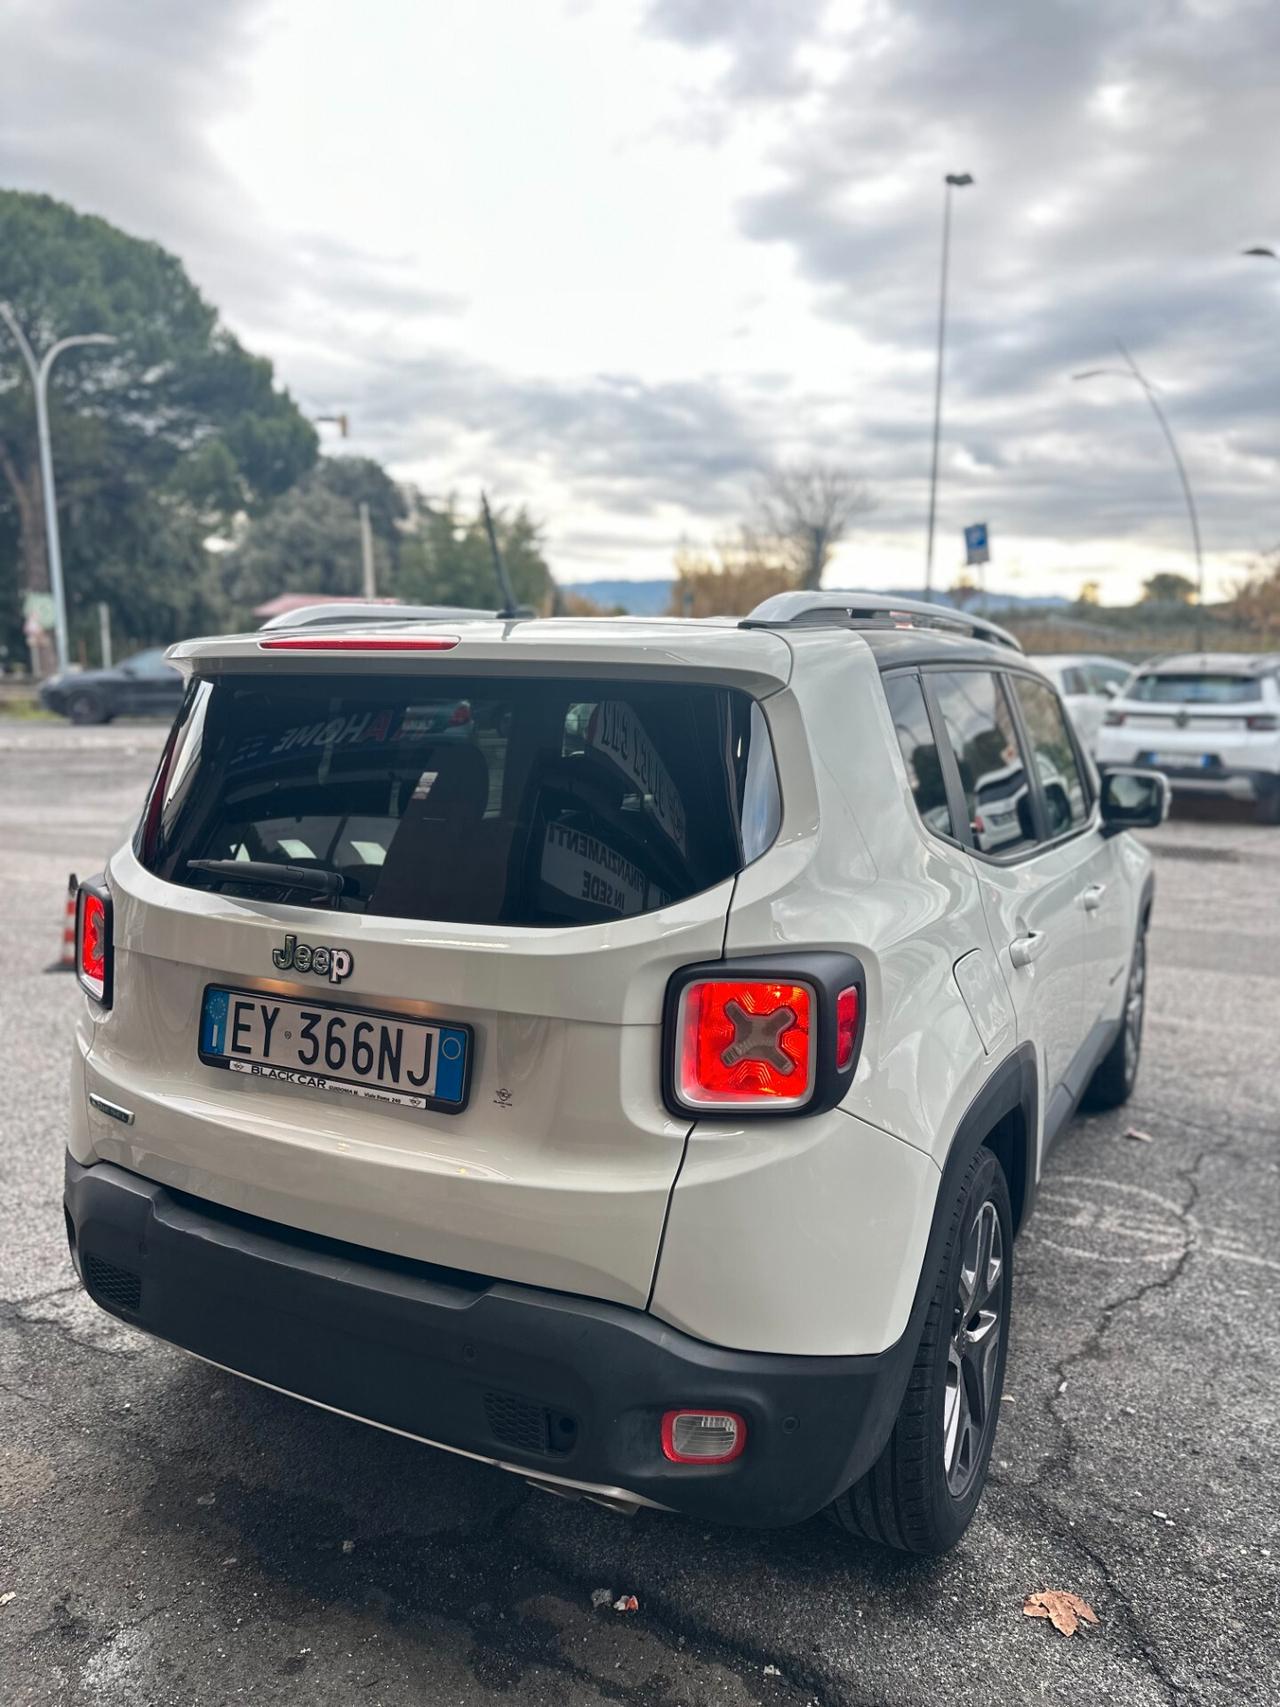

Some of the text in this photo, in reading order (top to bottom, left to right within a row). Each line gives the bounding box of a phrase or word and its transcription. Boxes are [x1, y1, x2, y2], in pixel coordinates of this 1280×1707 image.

[272, 934, 354, 984] Jeep
[231, 1001, 433, 1087] EY 366NJ
[251, 1065, 296, 1082] BLACK
[297, 1076, 327, 1089] CAR
